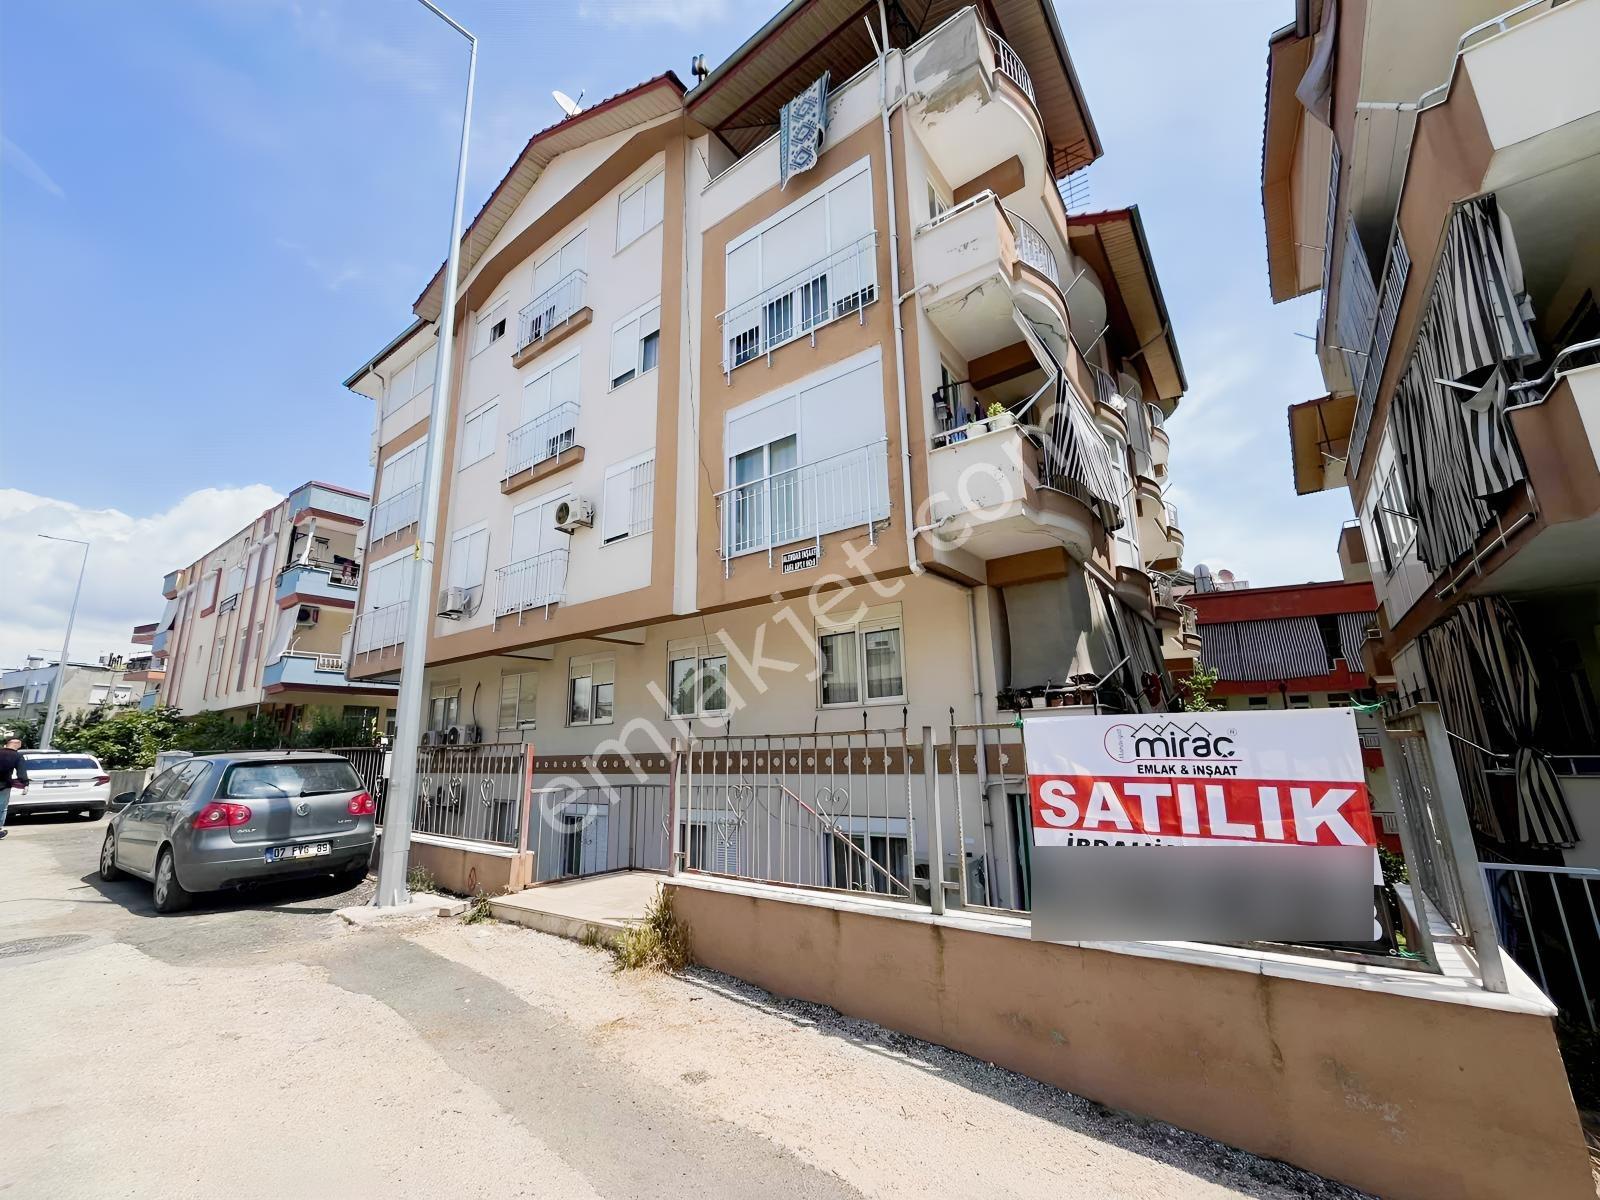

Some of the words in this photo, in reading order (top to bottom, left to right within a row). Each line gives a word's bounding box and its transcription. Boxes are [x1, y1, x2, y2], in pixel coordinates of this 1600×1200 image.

[1137, 764, 1176, 775] EMLAK
[1181, 765, 1189, 775] &
[1039, 779, 1367, 847] SATILIK
[274, 847, 286, 858] 07
[316, 843, 328, 853] 89
